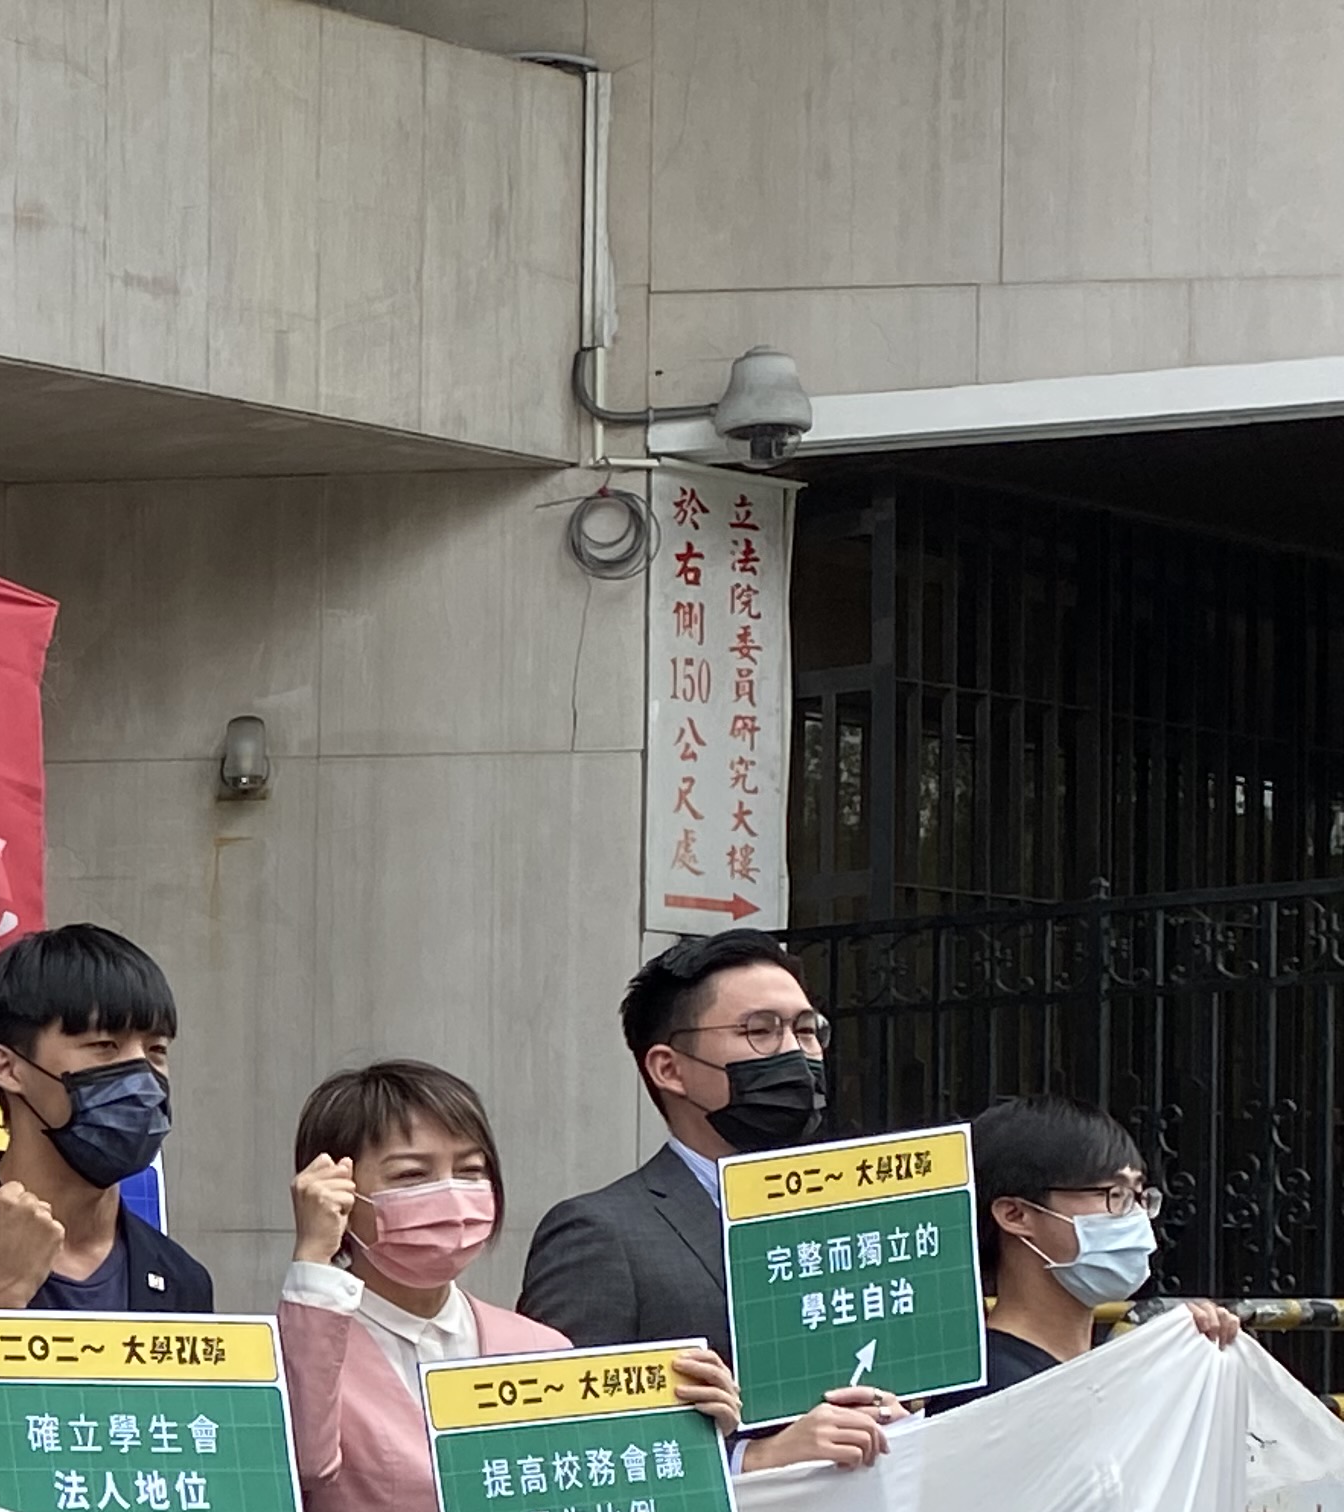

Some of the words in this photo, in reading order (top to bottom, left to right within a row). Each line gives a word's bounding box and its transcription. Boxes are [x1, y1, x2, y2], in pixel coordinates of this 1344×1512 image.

[670, 486, 712, 878] 於右側150公尺處
[724, 493, 764, 886] 立法院委員研究大樓
[766, 1221, 940, 1284] 完整而獨立的
[801, 1277, 915, 1331] 學生自治
[122, 1334, 226, 1366] 大學改革
[578, 1364, 667, 1400] 大學改革
[25, 1413, 220, 1455] 確立學生會
[53, 1469, 211, 1512] 法人地位
[481, 1440, 685, 1499] 提高校務會議
